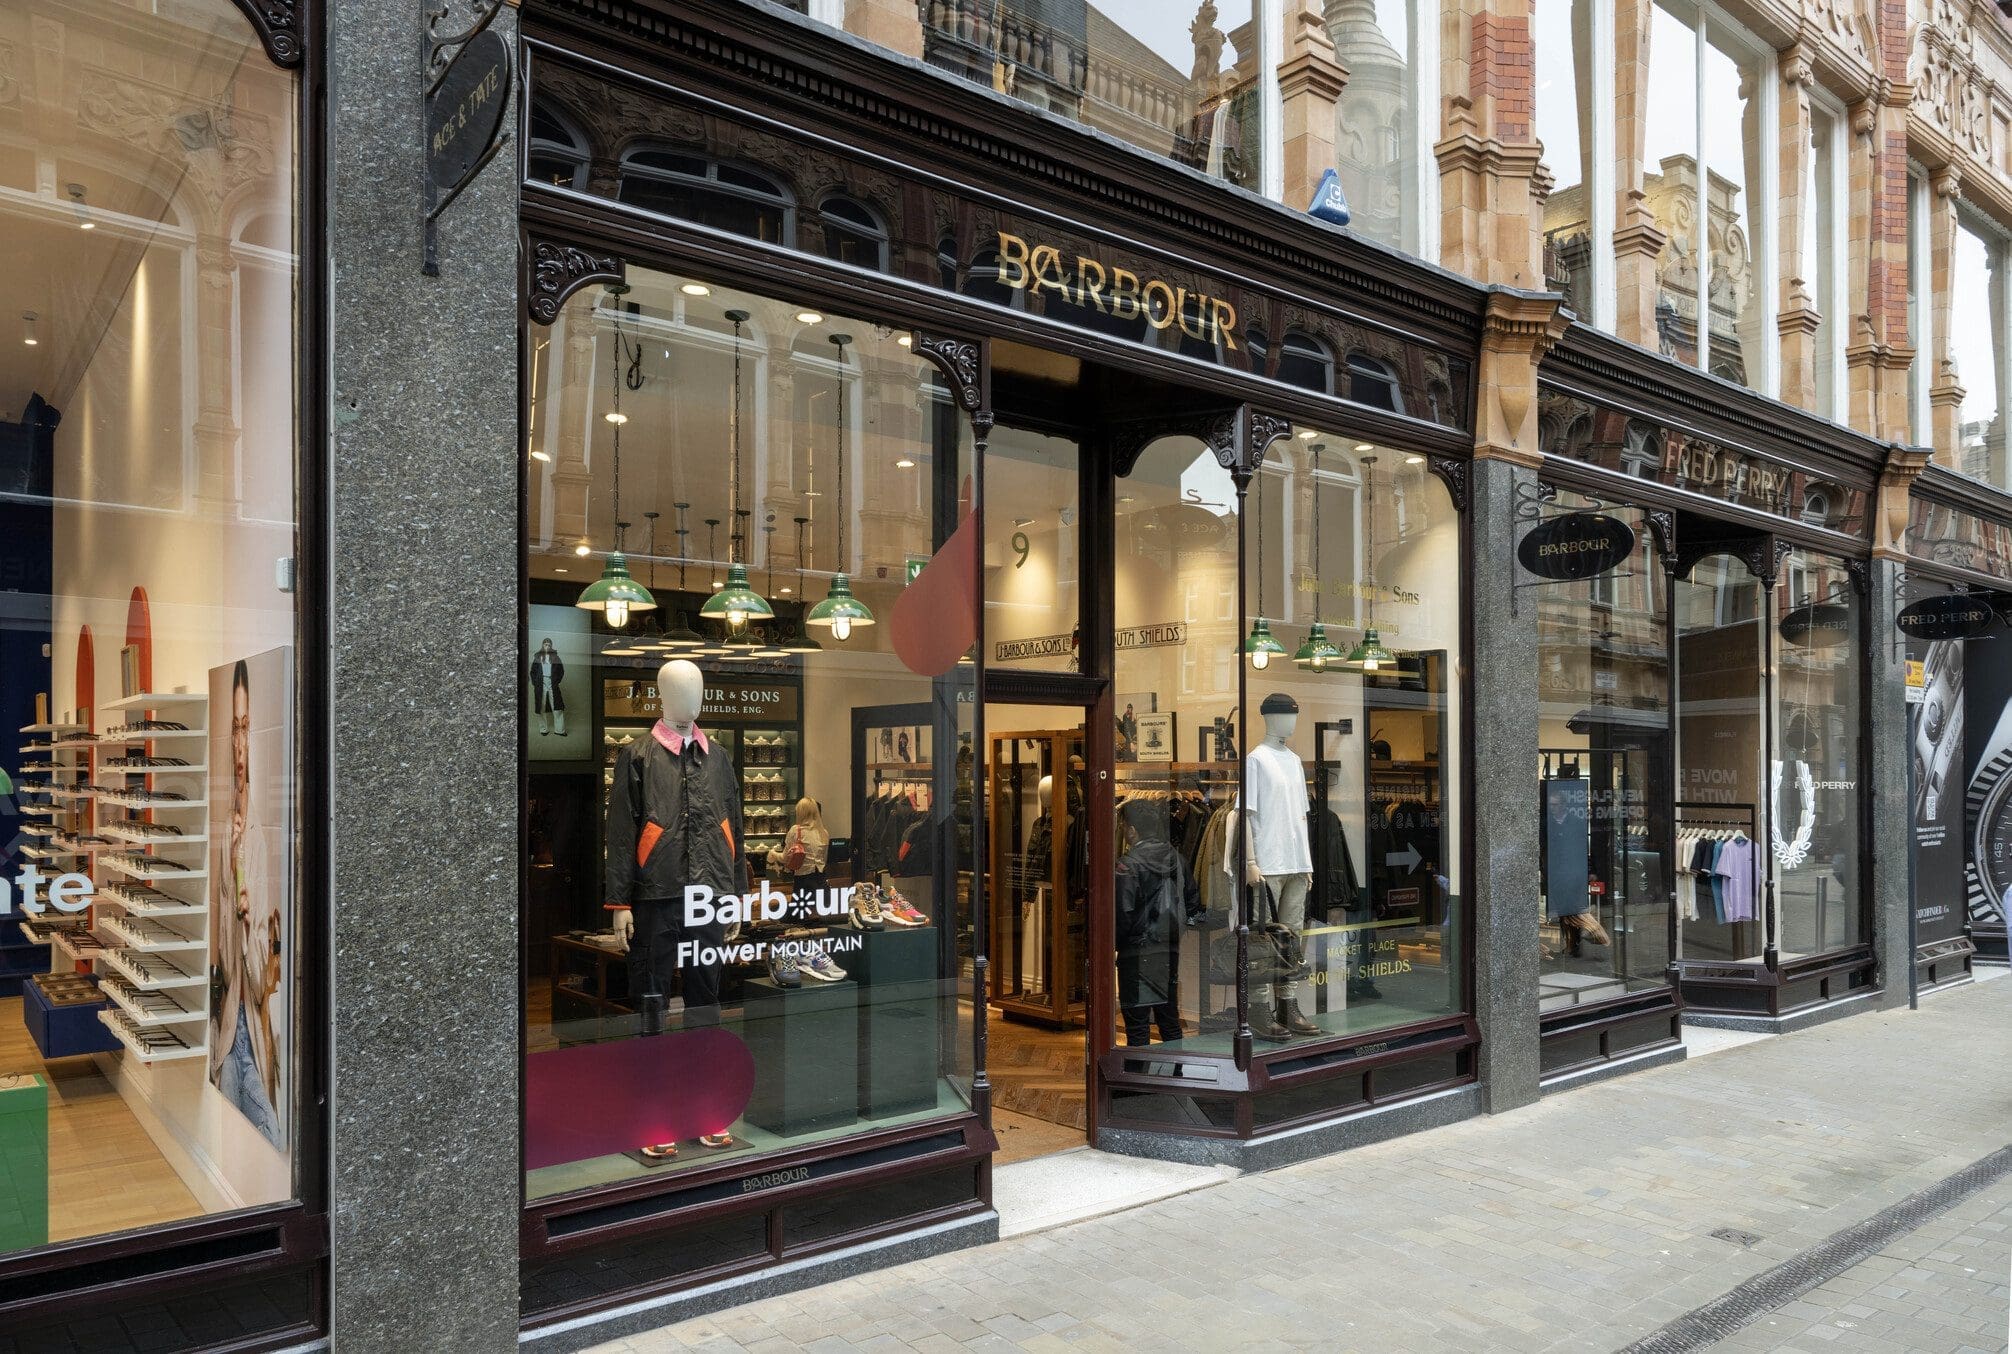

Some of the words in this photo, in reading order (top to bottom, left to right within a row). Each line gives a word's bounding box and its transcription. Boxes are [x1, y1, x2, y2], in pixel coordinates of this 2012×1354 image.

[434, 115, 456, 157] ACE
[458, 103, 466, 129] &
[469, 64, 498, 115] TATE
[995, 231, 1238, 350] BARBOUR
[1664, 439, 1718, 485] FRED
[1723, 457, 1788, 504] PERRY
[1012, 532, 1029, 569] 9
[1540, 538, 1610, 557] BARBOUR
[1393, 585, 1420, 605] Sons
[1901, 614, 1936, 626] FRED
[1941, 611, 1985, 623] PERRY
[1140, 626, 1180, 644] SHIELDS
[1041, 638, 1061, 654] SONS
[1340, 641, 1348, 653] &
[627, 687, 639, 699] J.
[729, 691, 737, 699] &
[741, 690, 780, 703] SONS
[643, 703, 656, 711] OF
[702, 704, 740, 714] HIELDS,
[743, 706, 765, 715] ENG.
[1821, 781, 1856, 790] PERRY
[677, 939, 768, 968] Flower
[771, 935, 862, 958] MOUNTAIN
[1327, 943, 1361, 959] MARKET
[1369, 938, 1395, 952] PLACE
[1355, 1042, 1388, 1057] BARBOUR
[743, 1167, 809, 1192] BARBOUR
